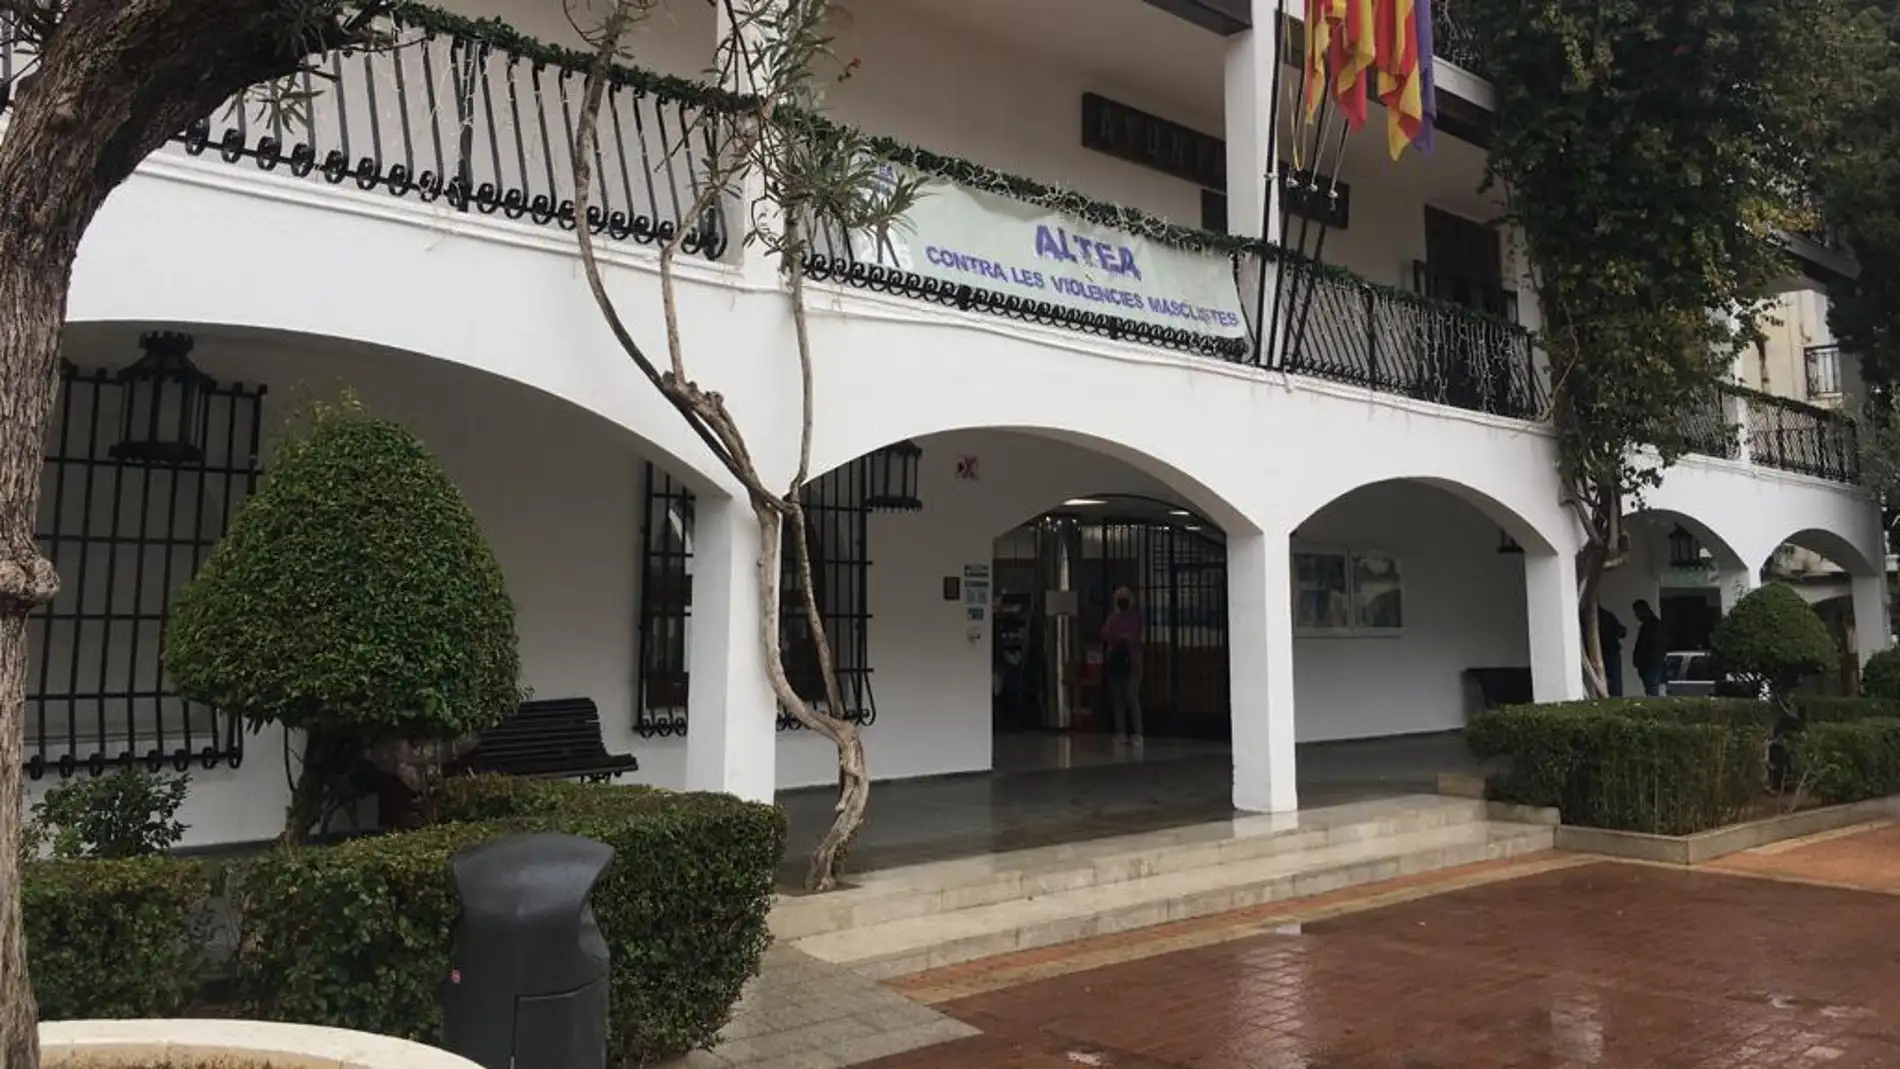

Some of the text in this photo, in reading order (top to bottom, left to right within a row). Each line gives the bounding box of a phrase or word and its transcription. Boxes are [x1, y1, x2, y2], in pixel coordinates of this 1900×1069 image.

[925, 246, 1008, 284] CONTRA
[1010, 266, 1046, 290] LES
[1035, 225, 1142, 282] ALTEA
